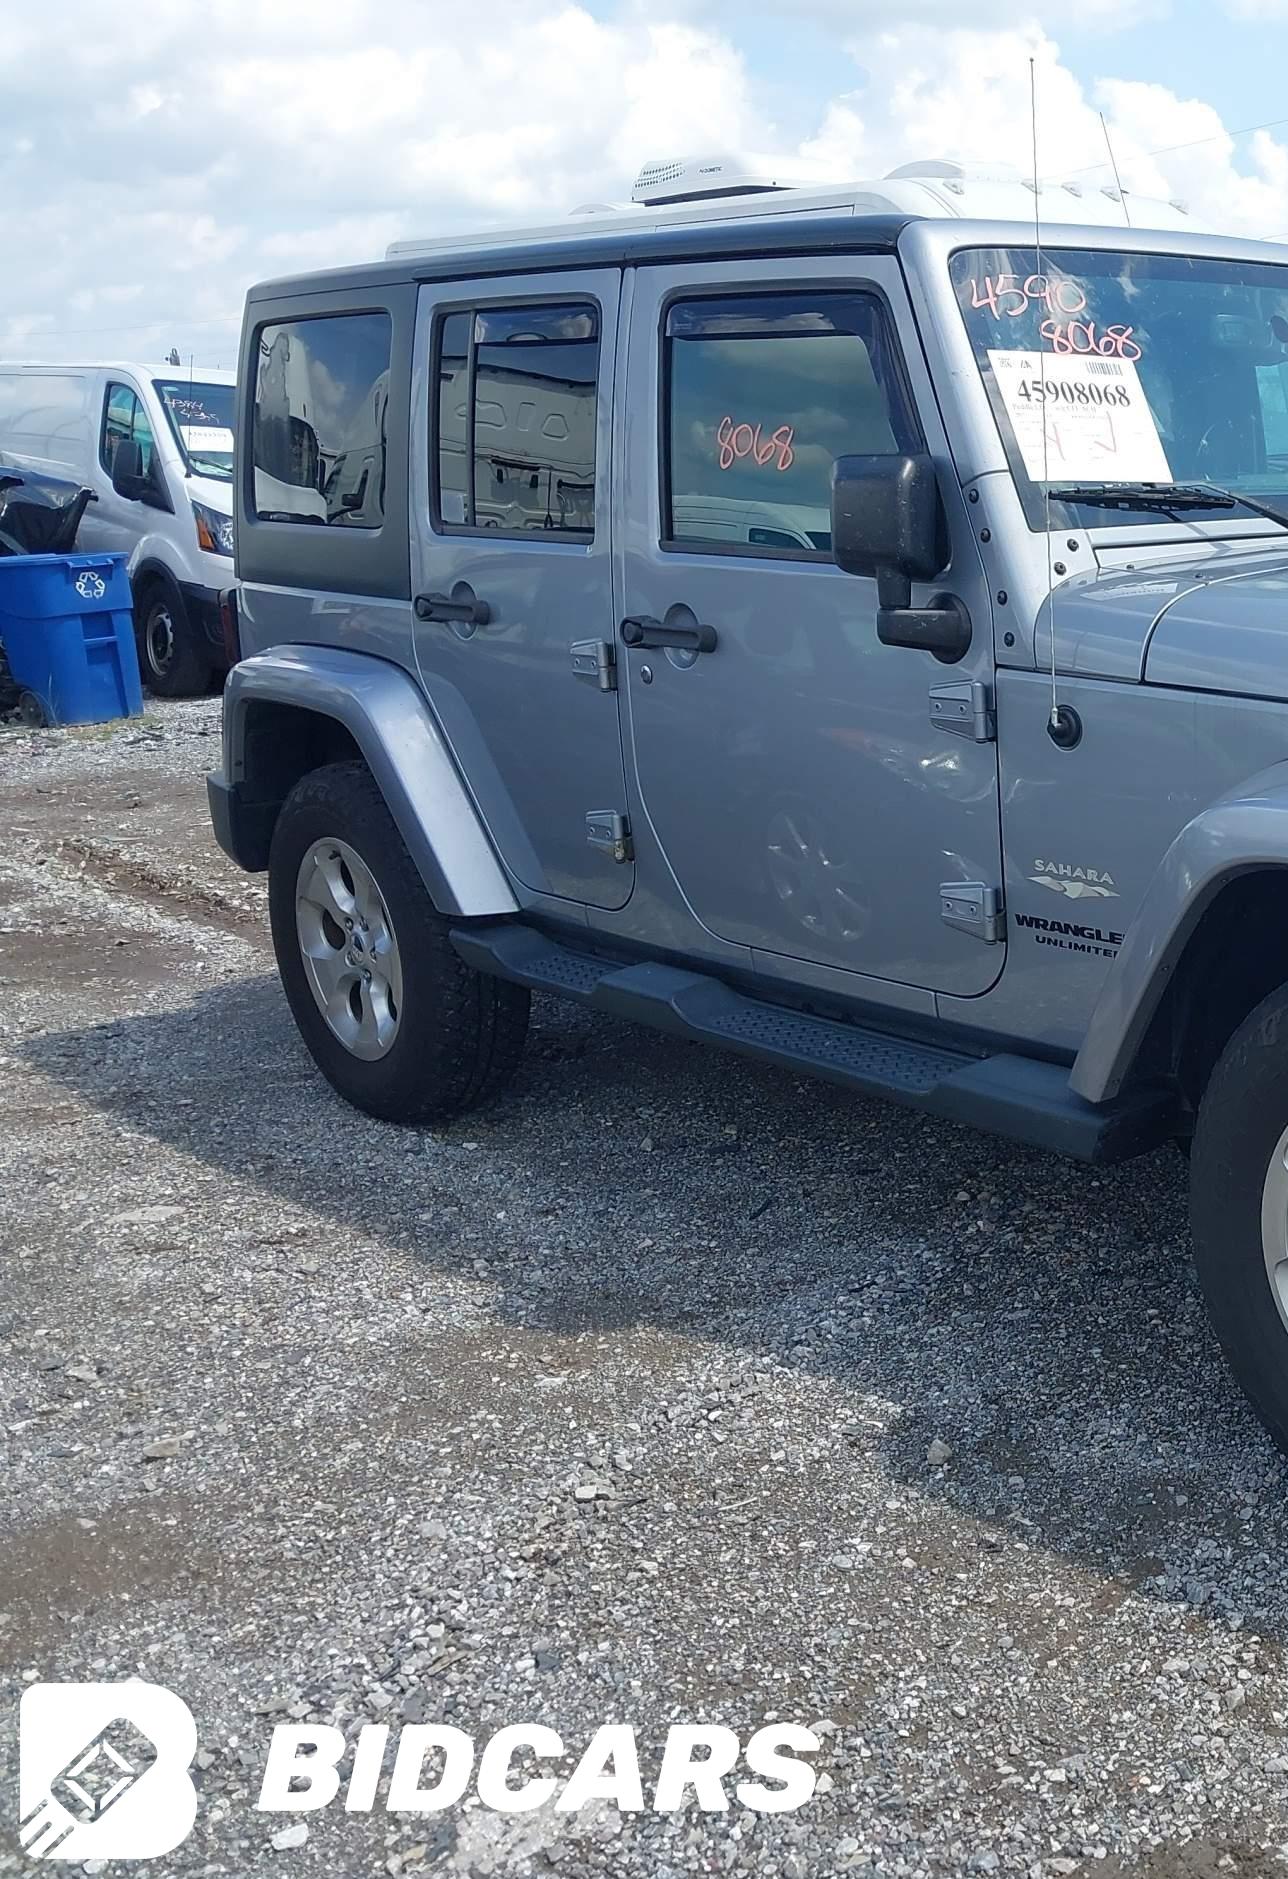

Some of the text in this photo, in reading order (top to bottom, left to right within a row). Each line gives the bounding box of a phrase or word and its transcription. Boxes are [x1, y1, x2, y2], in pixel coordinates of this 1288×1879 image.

[970, 274, 1086, 320] 4590
[1039, 319, 1142, 362] 8068
[1017, 379, 1131, 408] 45908068
[717, 416, 794, 470] 8068
[1034, 859, 1114, 885] SAHARA
[1015, 912, 1126, 945] WRANGLE
